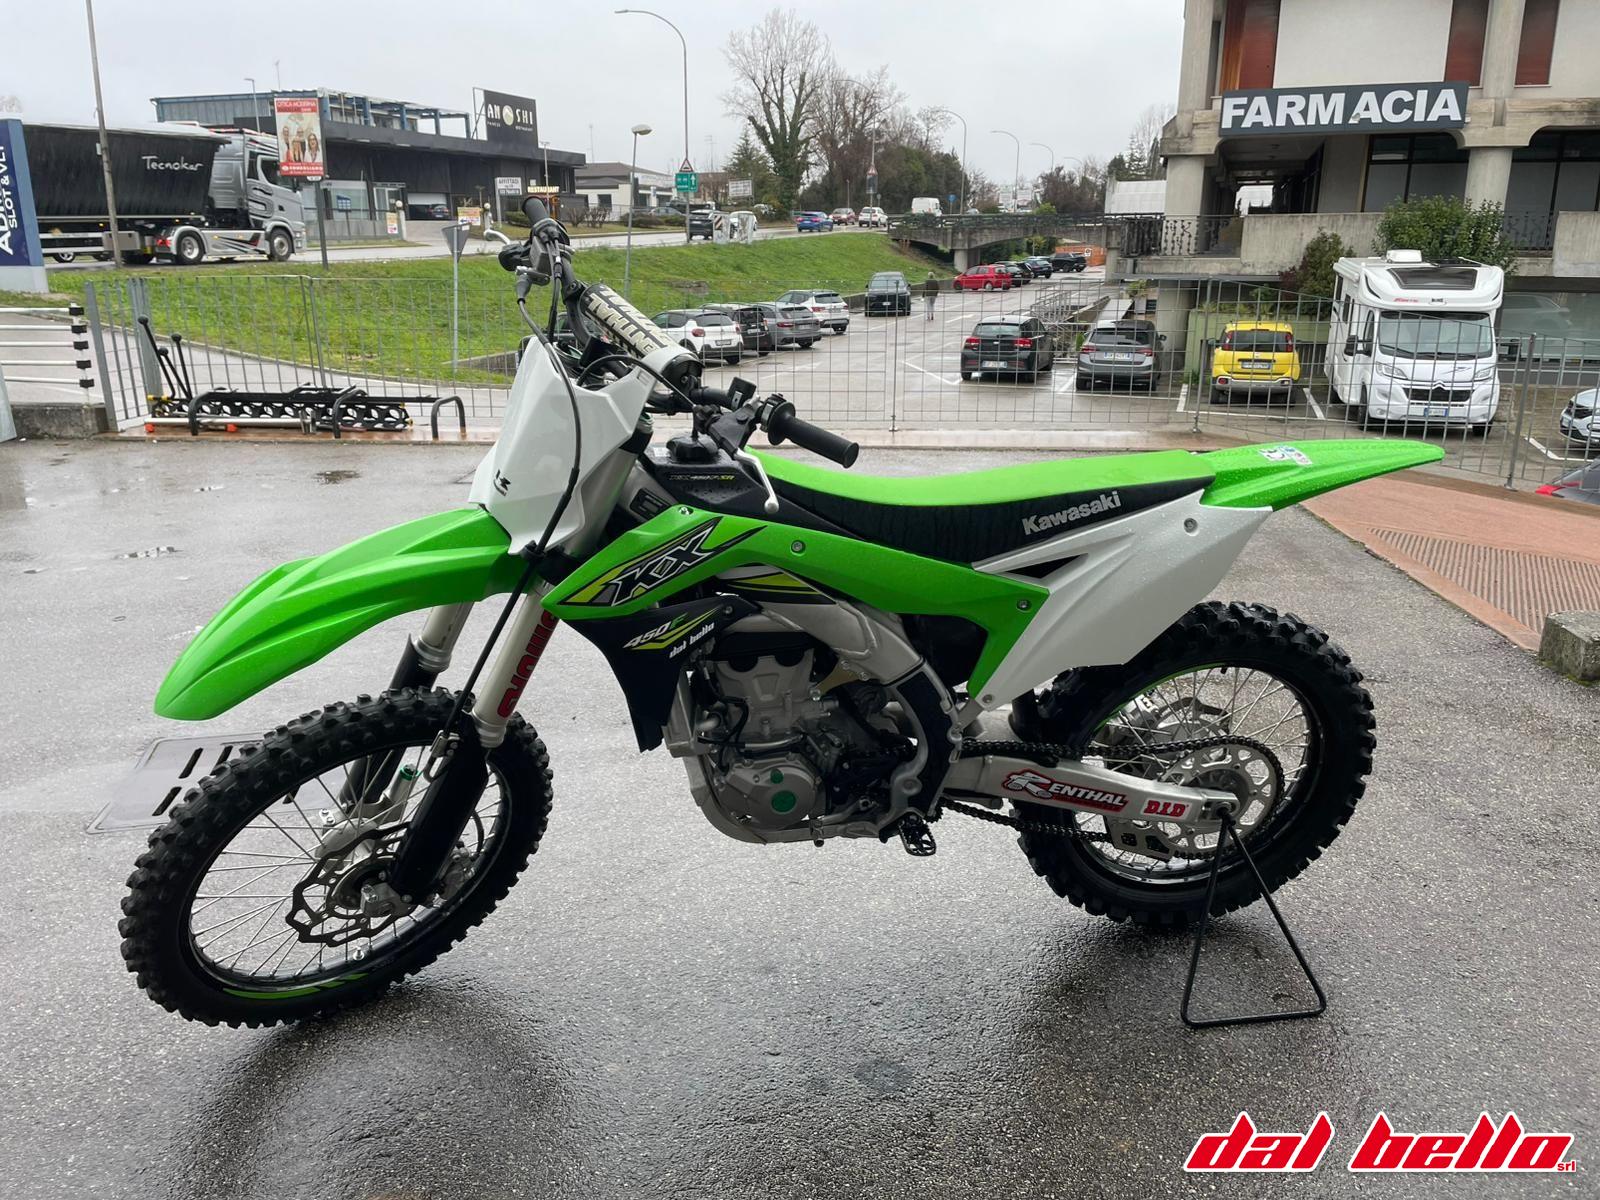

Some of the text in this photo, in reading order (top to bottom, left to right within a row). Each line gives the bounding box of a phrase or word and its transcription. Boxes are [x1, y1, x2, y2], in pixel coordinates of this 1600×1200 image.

[1221, 88, 1463, 129] FARMACIA
[0, 175, 10, 186] &
[2, 188, 18, 229] SLOT
[1021, 491, 1122, 536] Kawasaki
[611, 526, 710, 606] KX
[622, 612, 689, 649] 450F
[669, 640, 687, 659] dal
